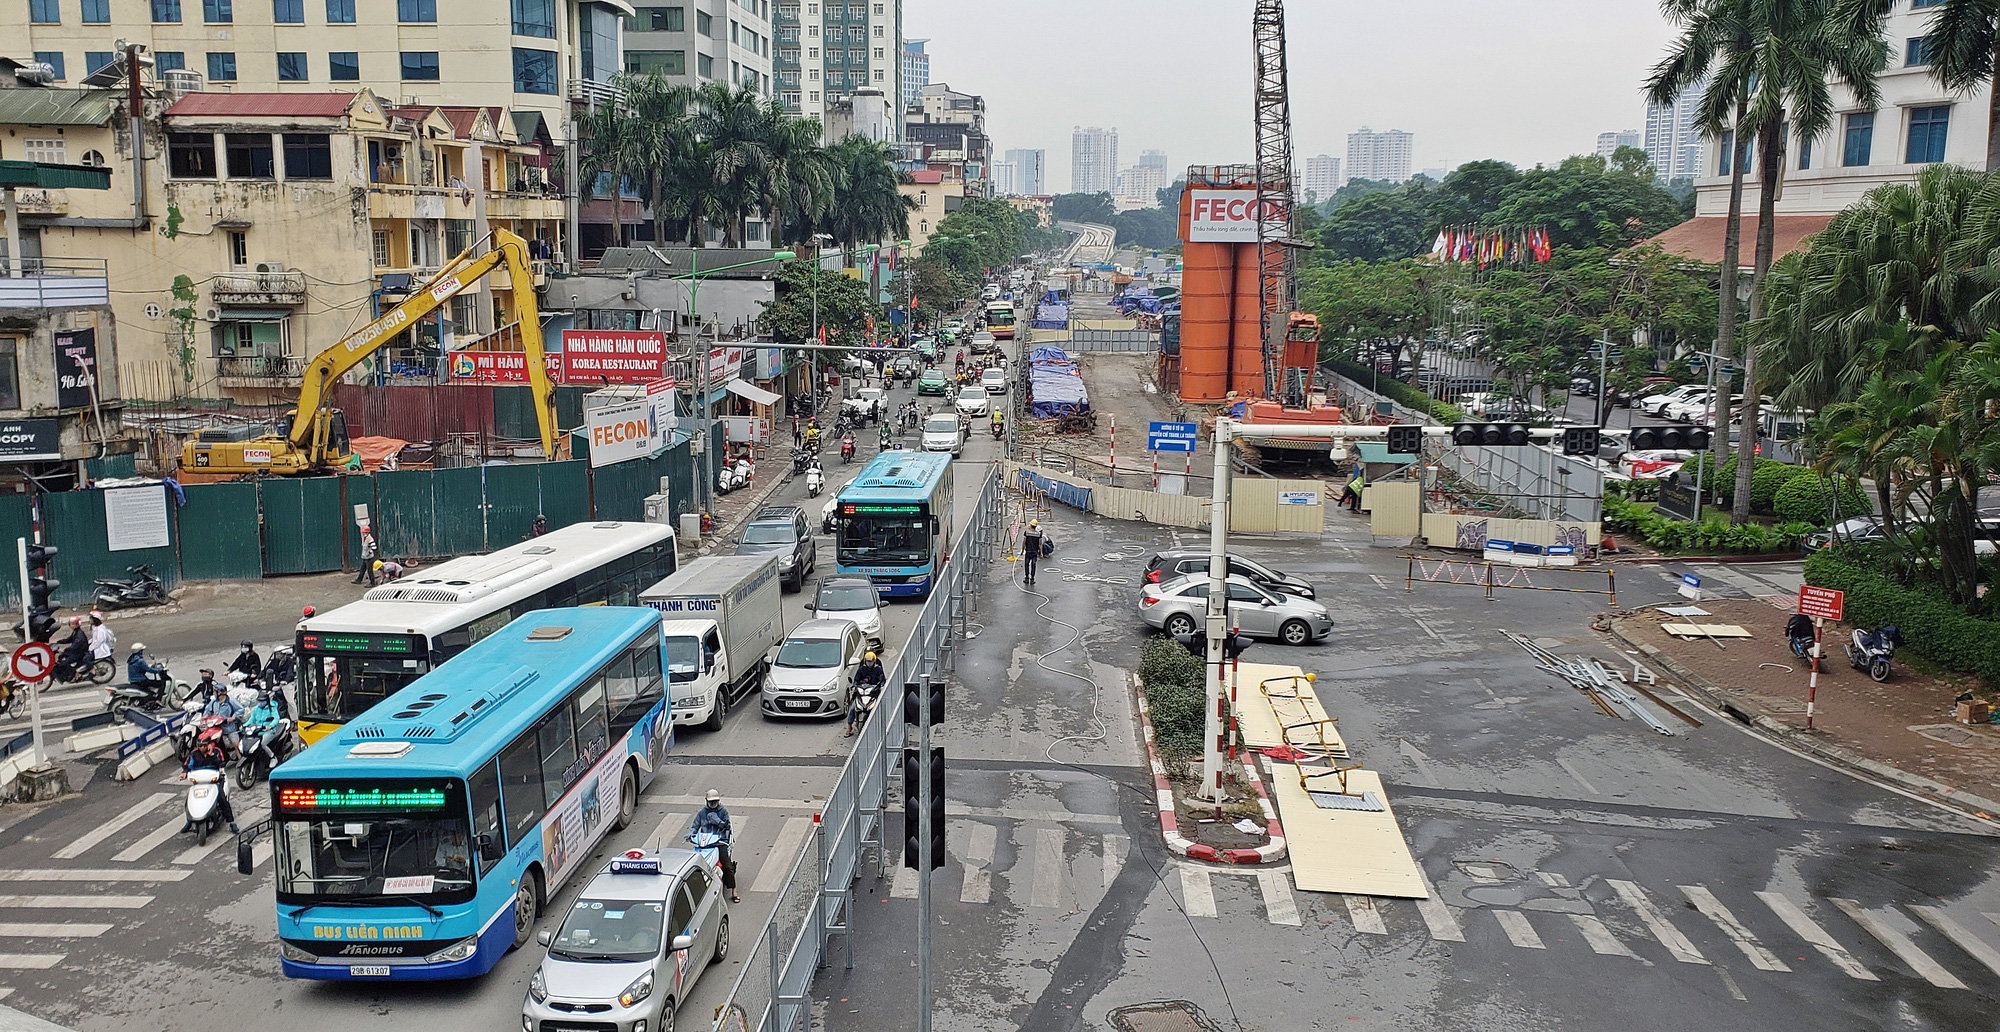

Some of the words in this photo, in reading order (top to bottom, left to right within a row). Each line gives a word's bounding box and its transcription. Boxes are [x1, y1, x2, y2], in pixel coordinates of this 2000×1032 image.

[433, 278, 457, 296] FECON
[344, 308, 407, 353] 0982584579
[567, 335, 588, 353] NHÀ
[588, 335, 615, 354] HÀNG
[615, 336, 635, 354] HÀN
[636, 334, 661, 355] QUỐC
[477, 354, 495, 369] MÌ
[497, 355, 524, 370] HÀN
[572, 357, 602, 370] KOREA
[602, 359, 659, 371] RESTAURANT
[3, 425, 22, 433] ANH
[593, 418, 648, 447] FECON
[0, 433, 36, 444] COPY
[245, 450, 270, 458] FECON
[648, 598, 683, 612] THÀNH
[687, 598, 717, 611] CÔNG
[313, 925, 342, 939] BUS
[346, 922, 379, 939] LIÊN
[383, 925, 423, 939] NINH
